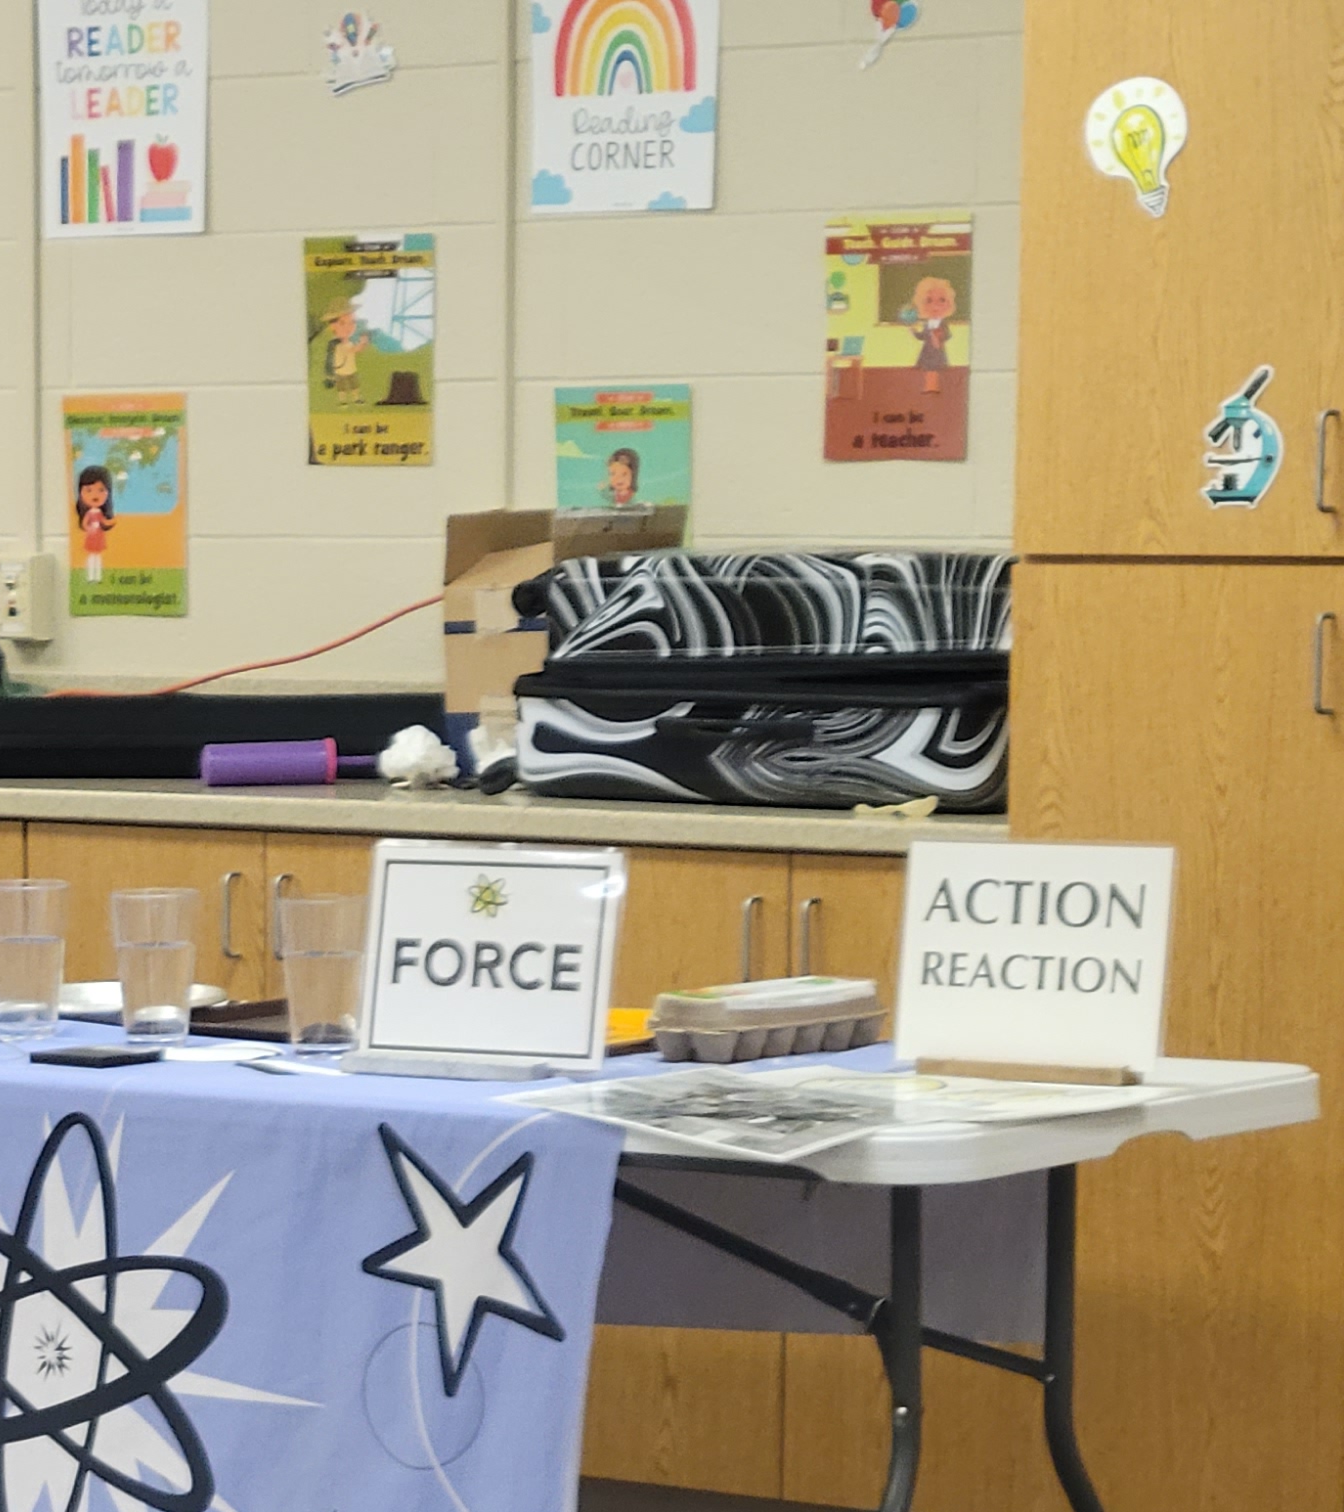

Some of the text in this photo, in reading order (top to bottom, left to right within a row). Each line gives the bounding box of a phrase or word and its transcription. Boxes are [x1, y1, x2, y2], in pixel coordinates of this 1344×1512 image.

[66, 20, 182, 58] READER
[56, 59, 193, 84] tomorrow a
[70, 83, 179, 120] LEADER
[572, 106, 676, 138] Reading
[570, 139, 675, 171] CORNER
[332, 440, 368, 461] park
[374, 441, 429, 462] ranger.
[923, 878, 1147, 929] ACTION
[390, 937, 584, 992] FORCE
[920, 951, 1144, 995] REACTION
